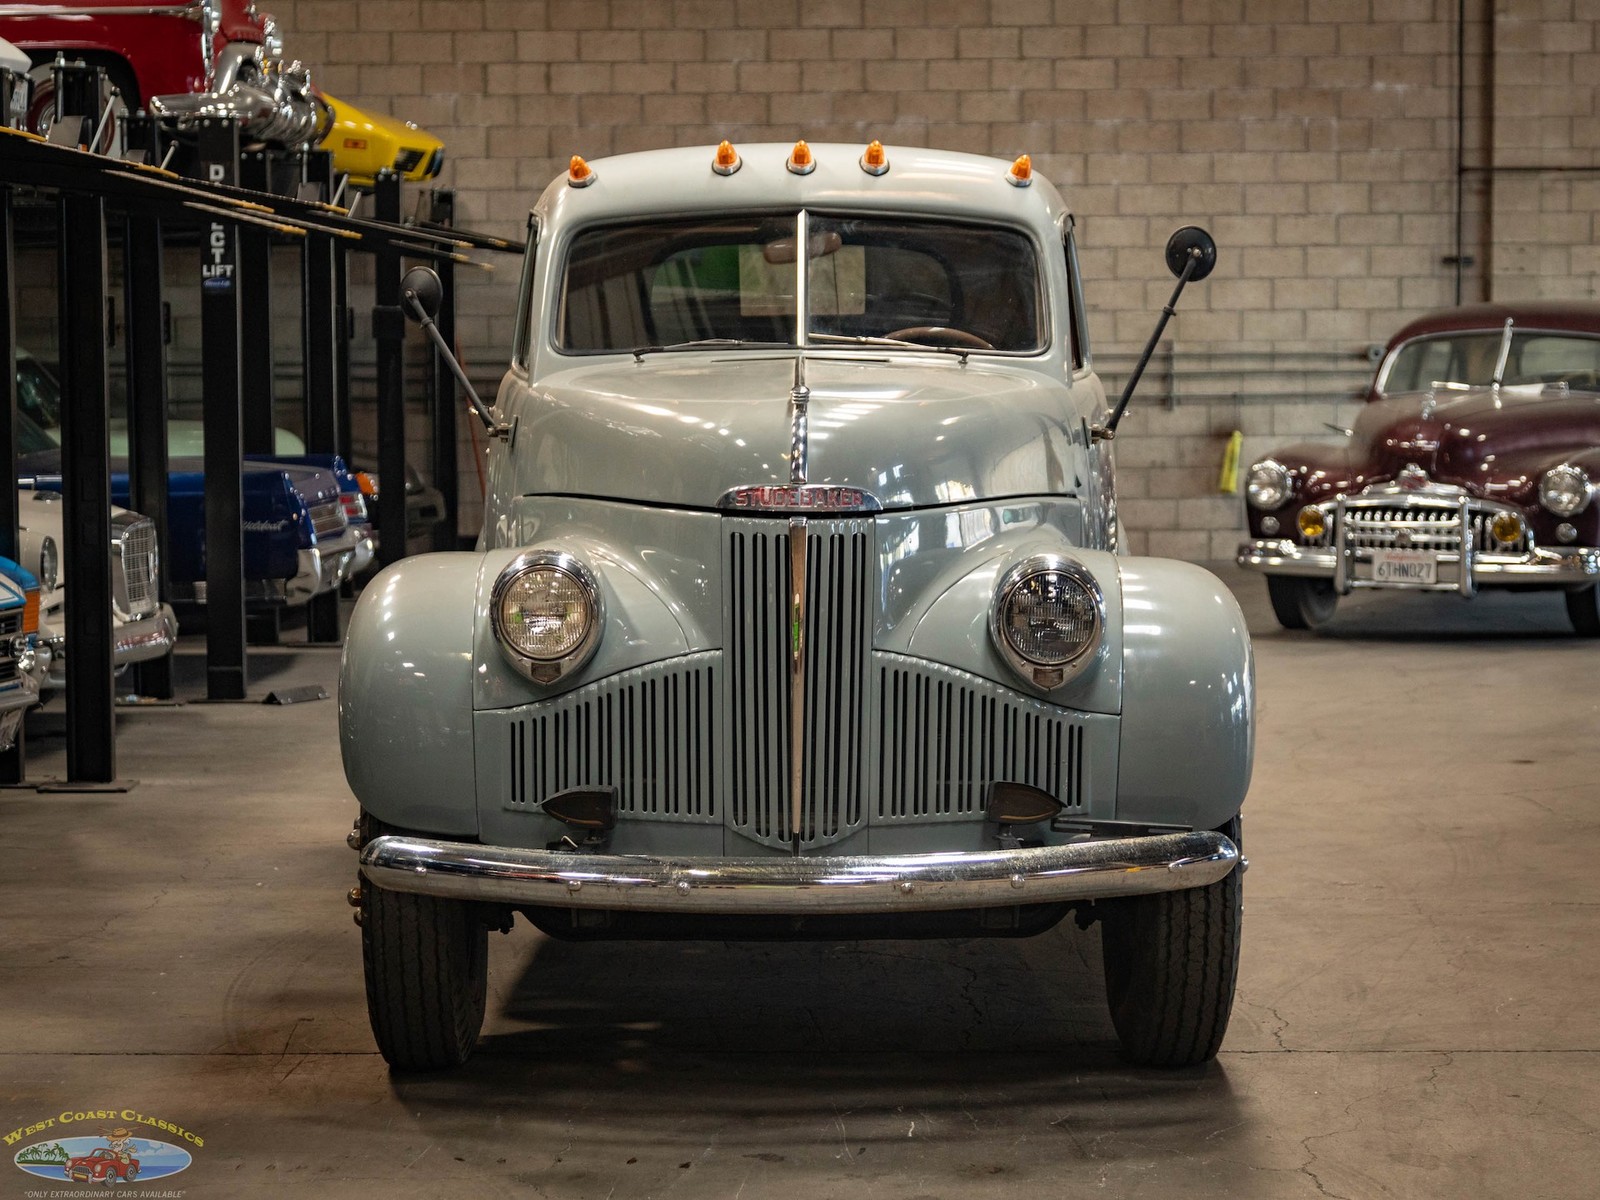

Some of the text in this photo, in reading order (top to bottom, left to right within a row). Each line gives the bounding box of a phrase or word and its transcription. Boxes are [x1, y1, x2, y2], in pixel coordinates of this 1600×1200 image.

[209, 164, 225, 264] DCT
[202, 264, 234, 278] LIFT
[735, 487, 863, 507] STUDEBAKER
[1378, 562, 1432, 578] 6THN027
